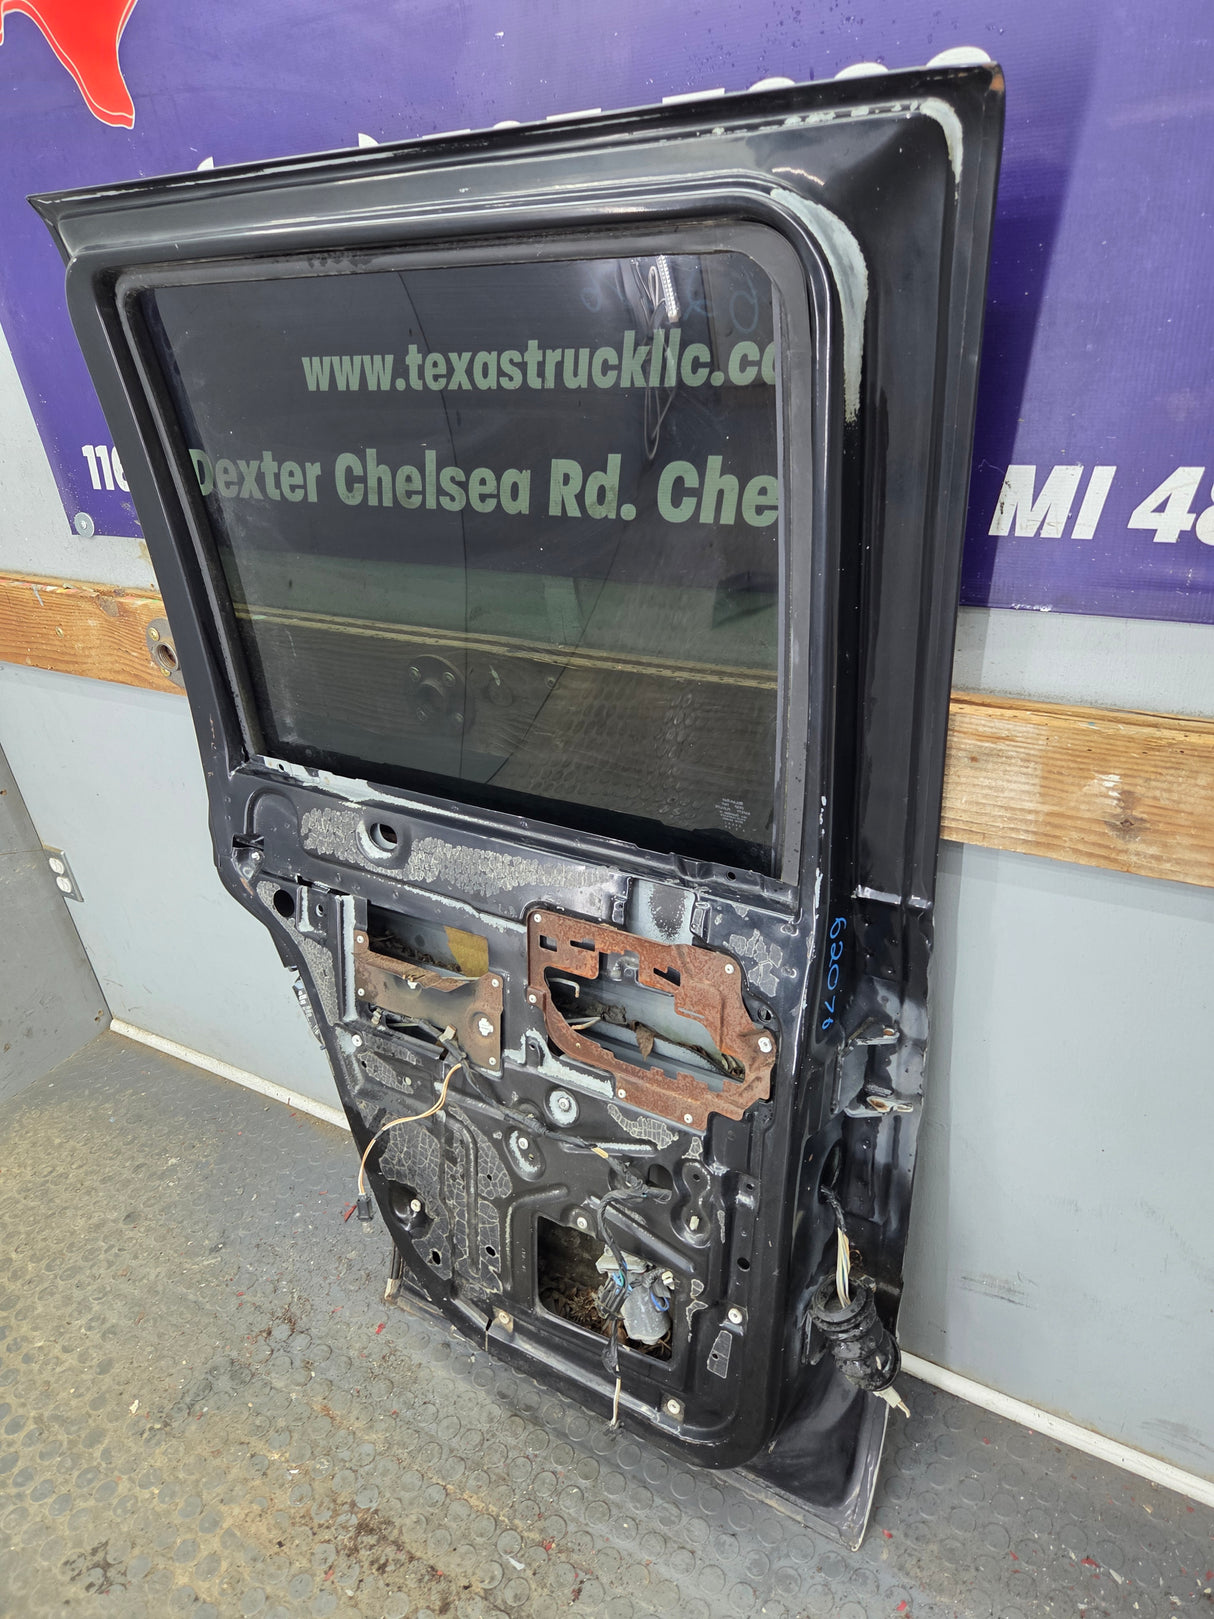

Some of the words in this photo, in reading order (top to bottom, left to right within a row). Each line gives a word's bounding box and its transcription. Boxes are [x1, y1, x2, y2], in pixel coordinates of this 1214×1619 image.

[188, 448, 322, 503] Dexter
[334, 448, 531, 515] Chelsea
[548, 453, 637, 521] Rd.
[656, 455, 779, 527] Che
[987, 464, 1117, 540] MI
